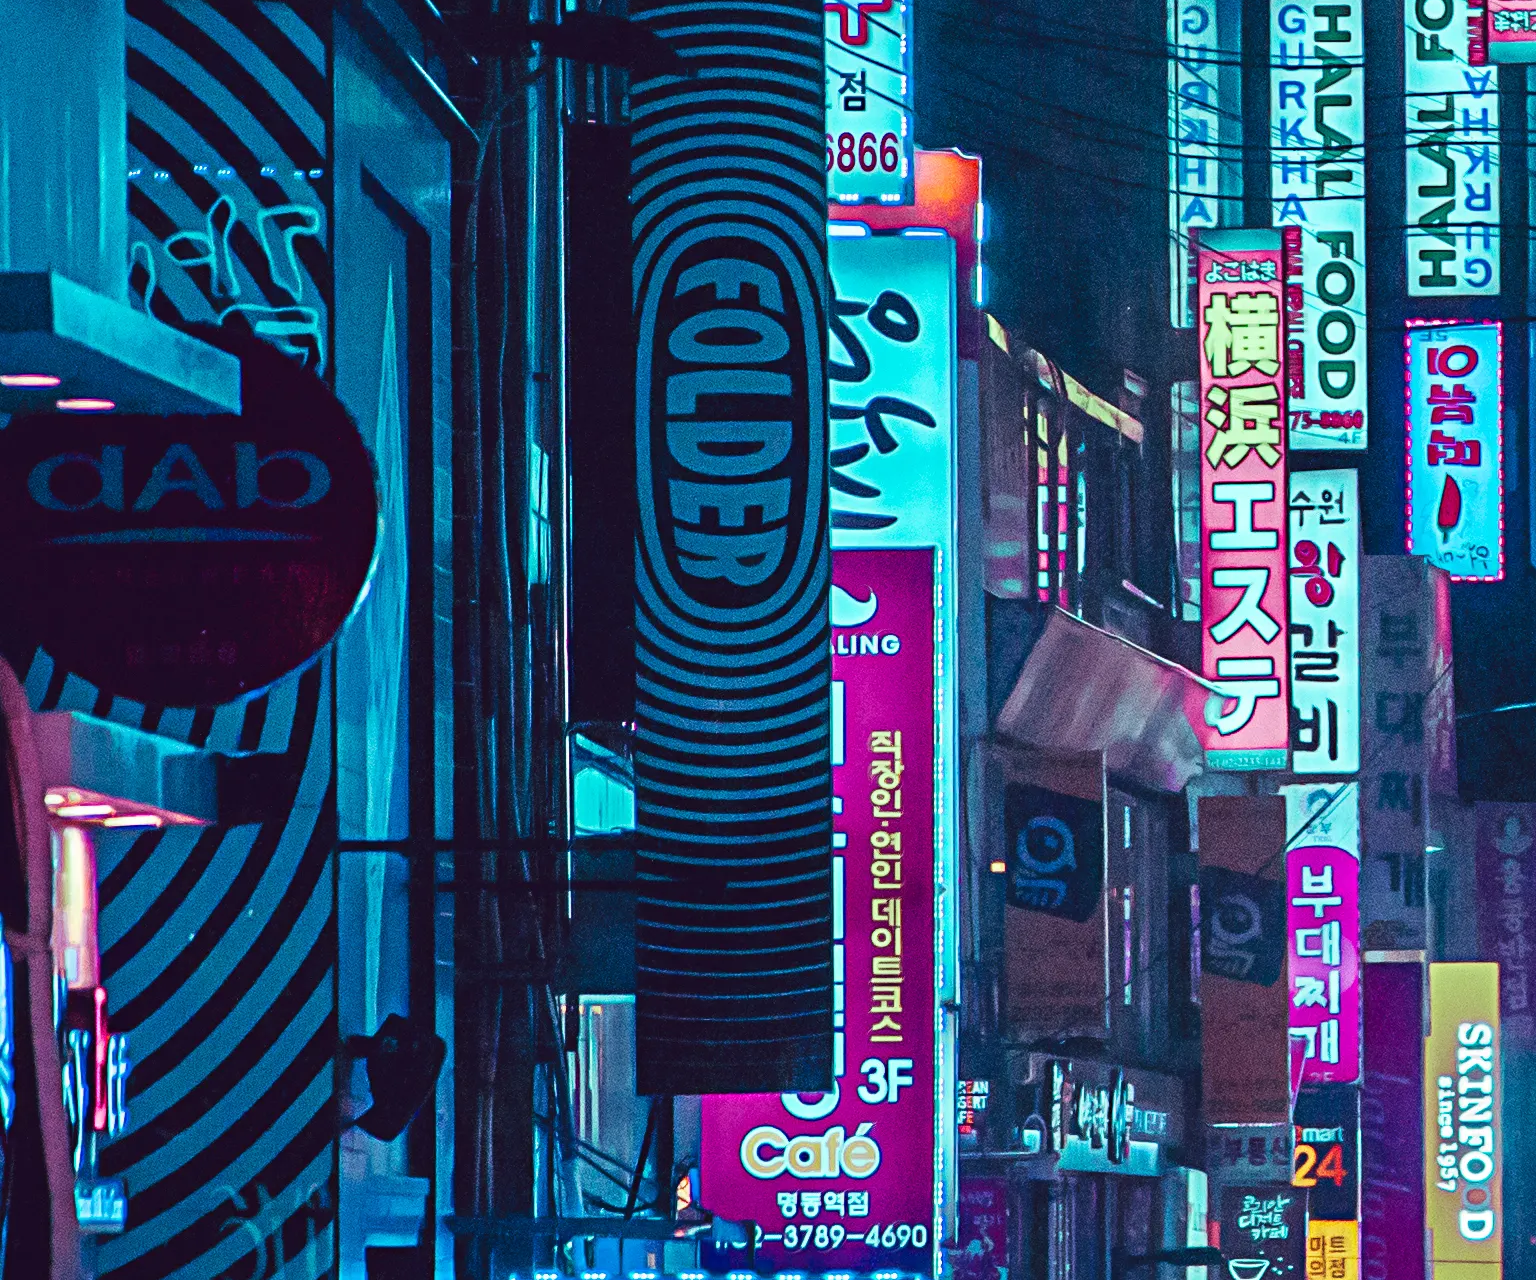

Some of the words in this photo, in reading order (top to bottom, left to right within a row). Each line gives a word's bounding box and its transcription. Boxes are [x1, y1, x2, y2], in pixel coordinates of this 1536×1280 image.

[1277, 3, 1309, 224] GURKHA
[1313, 3, 1354, 199] HALAL
[1460, 67, 1492, 288] GURKHA
[1415, 92, 1456, 288] HALAL
[1315, 230, 1358, 401] FOOD
[664, 256, 795, 587] FOLDER
[1203, 292, 1284, 736] 横浜エステ
[829, 633, 901, 656] LING
[867, 898, 905, 1044] 데이트코스
[1290, 864, 1343, 1065] 부대찌개
[739, 1122, 882, 1180] Café
[856, 1057, 913, 1105] 3F
[1292, 1143, 1348, 1188] 24
[1438, 1075, 1460, 1137] since
[1457, 1023, 1497, 1242] SKINFOOD
[777, 1190, 870, 1218] 명동역점
[1437, 1142, 1460, 1192] 1957
